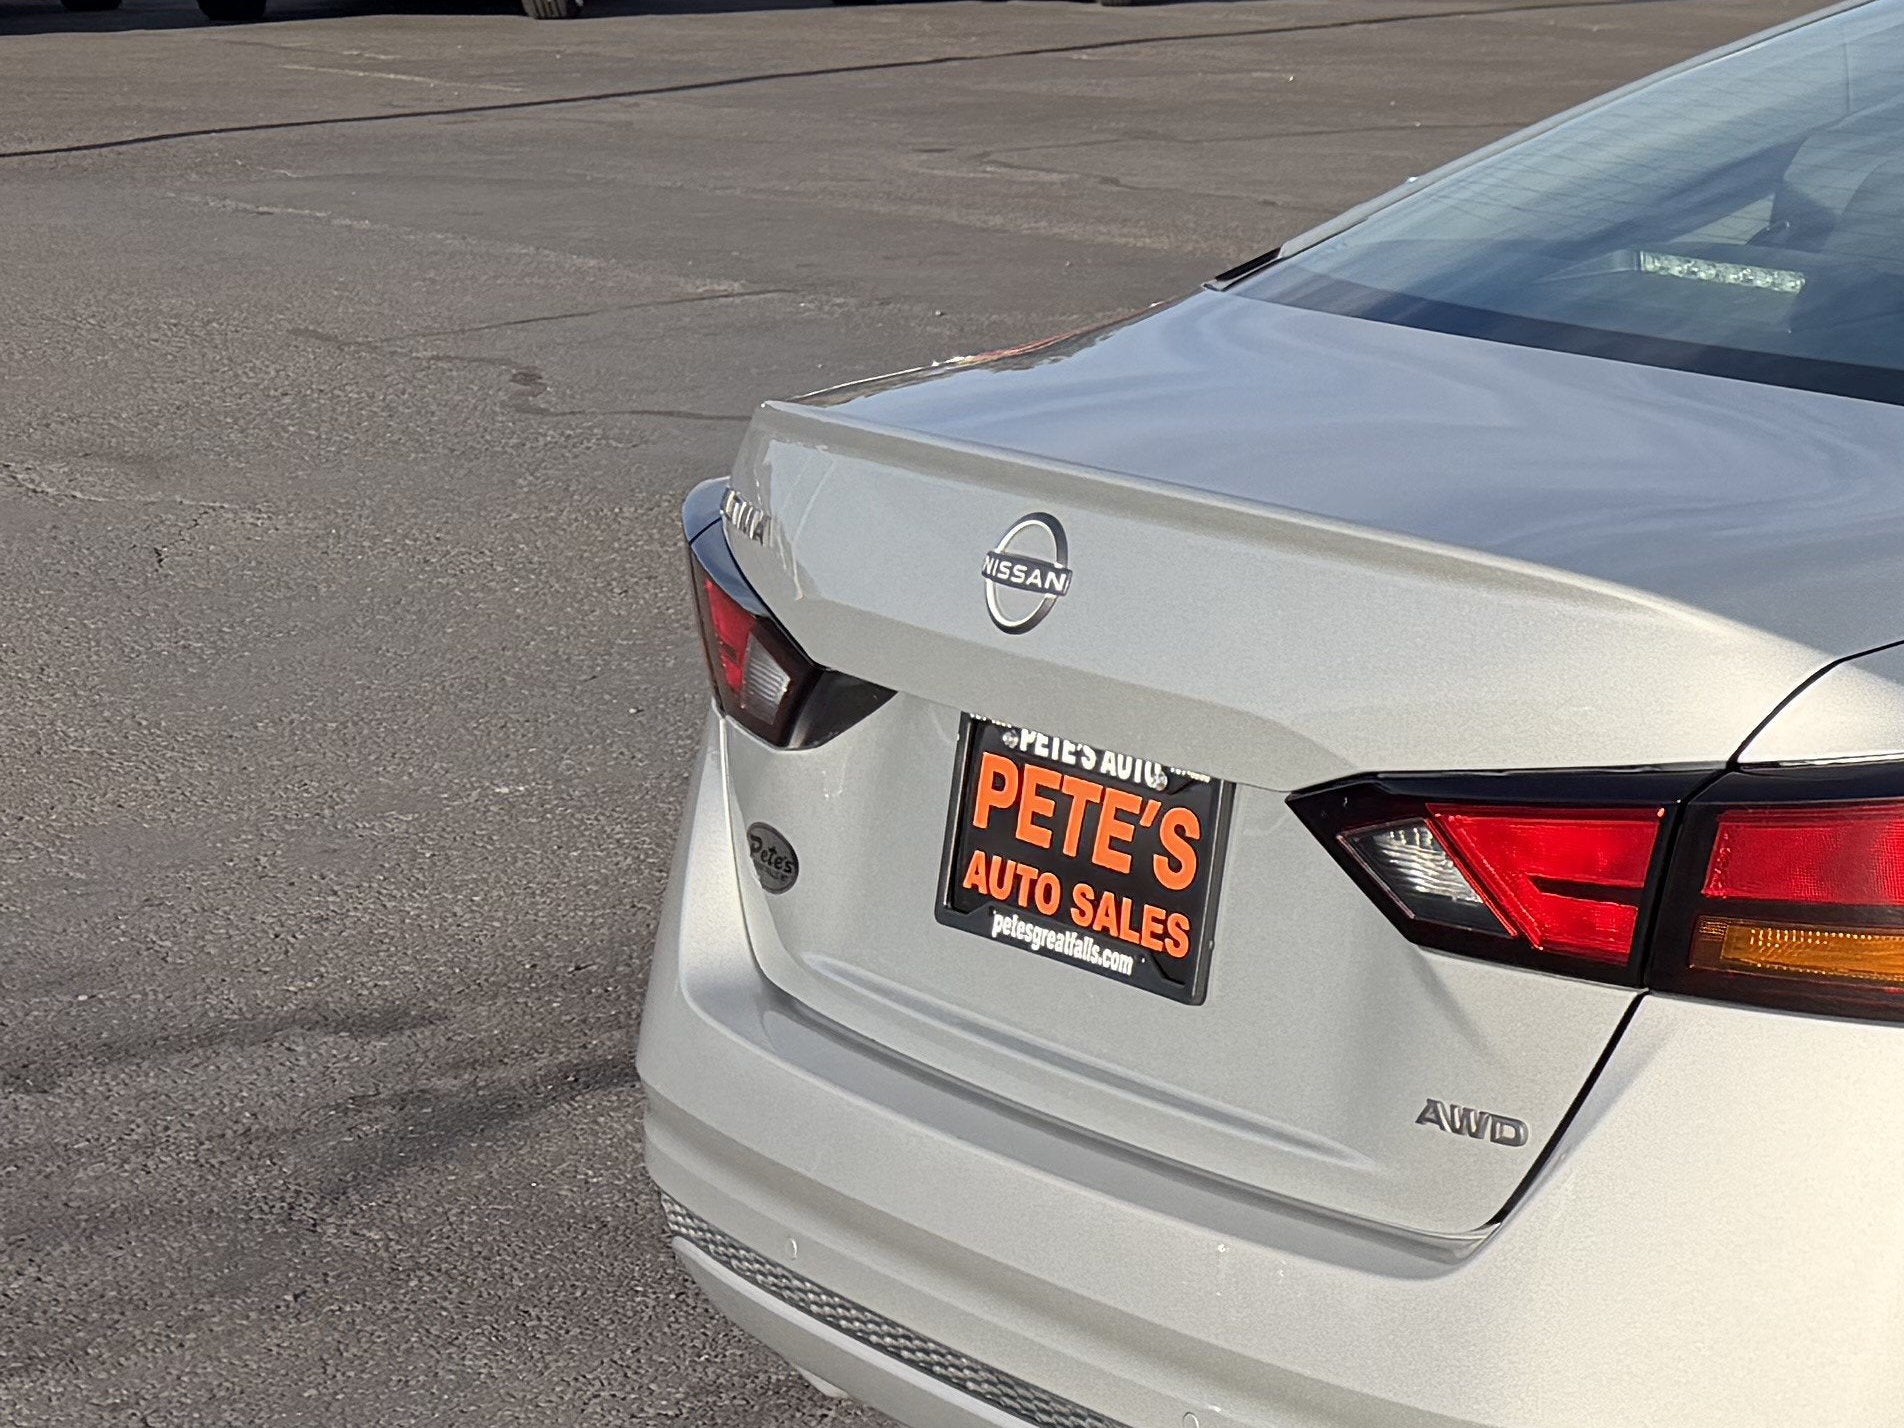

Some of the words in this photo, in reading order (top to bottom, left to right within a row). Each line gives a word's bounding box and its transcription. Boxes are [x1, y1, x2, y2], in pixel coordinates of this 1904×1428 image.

[983, 554, 1067, 592] NISSAN
[972, 751, 1200, 890] PETE'S
[962, 850, 1061, 915] AUTO
[1070, 883, 1190, 958] SALES
[991, 913, 1134, 975] petesgreatfalls.com
[1415, 1098, 1529, 1147] AWD
